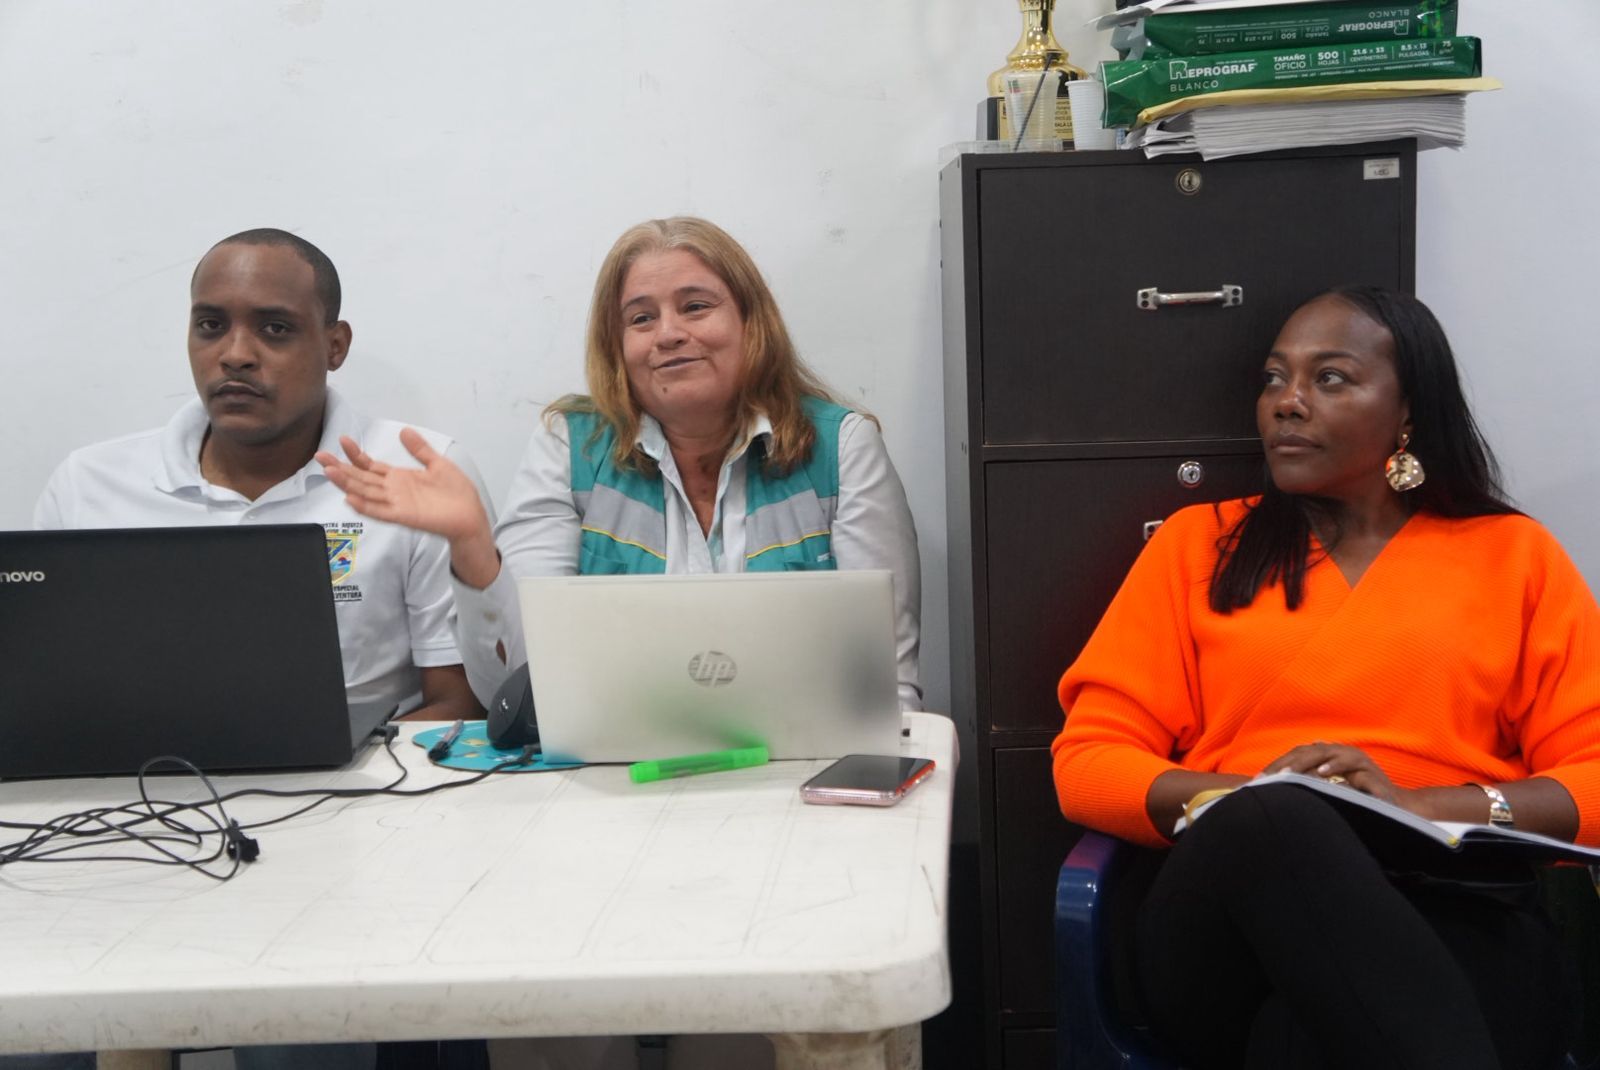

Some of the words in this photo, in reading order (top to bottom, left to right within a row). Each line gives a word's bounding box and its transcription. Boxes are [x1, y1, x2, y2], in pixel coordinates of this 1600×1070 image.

[1368, 8, 1410, 18] BLANCO
[1337, 18, 1409, 36] REPROGRAF
[1280, 32, 1297, 40] 500
[1400, 43, 1412, 51] 8.5
[1273, 53, 1306, 62] TAMAÑO
[1317, 50, 1339, 60] 500
[1398, 50, 1430, 58] PULGADAS
[1169, 60, 1257, 80] REPROGRAF
[1274, 61, 1306, 71] OFICIO
[1170, 80, 1219, 92] BLANCO
